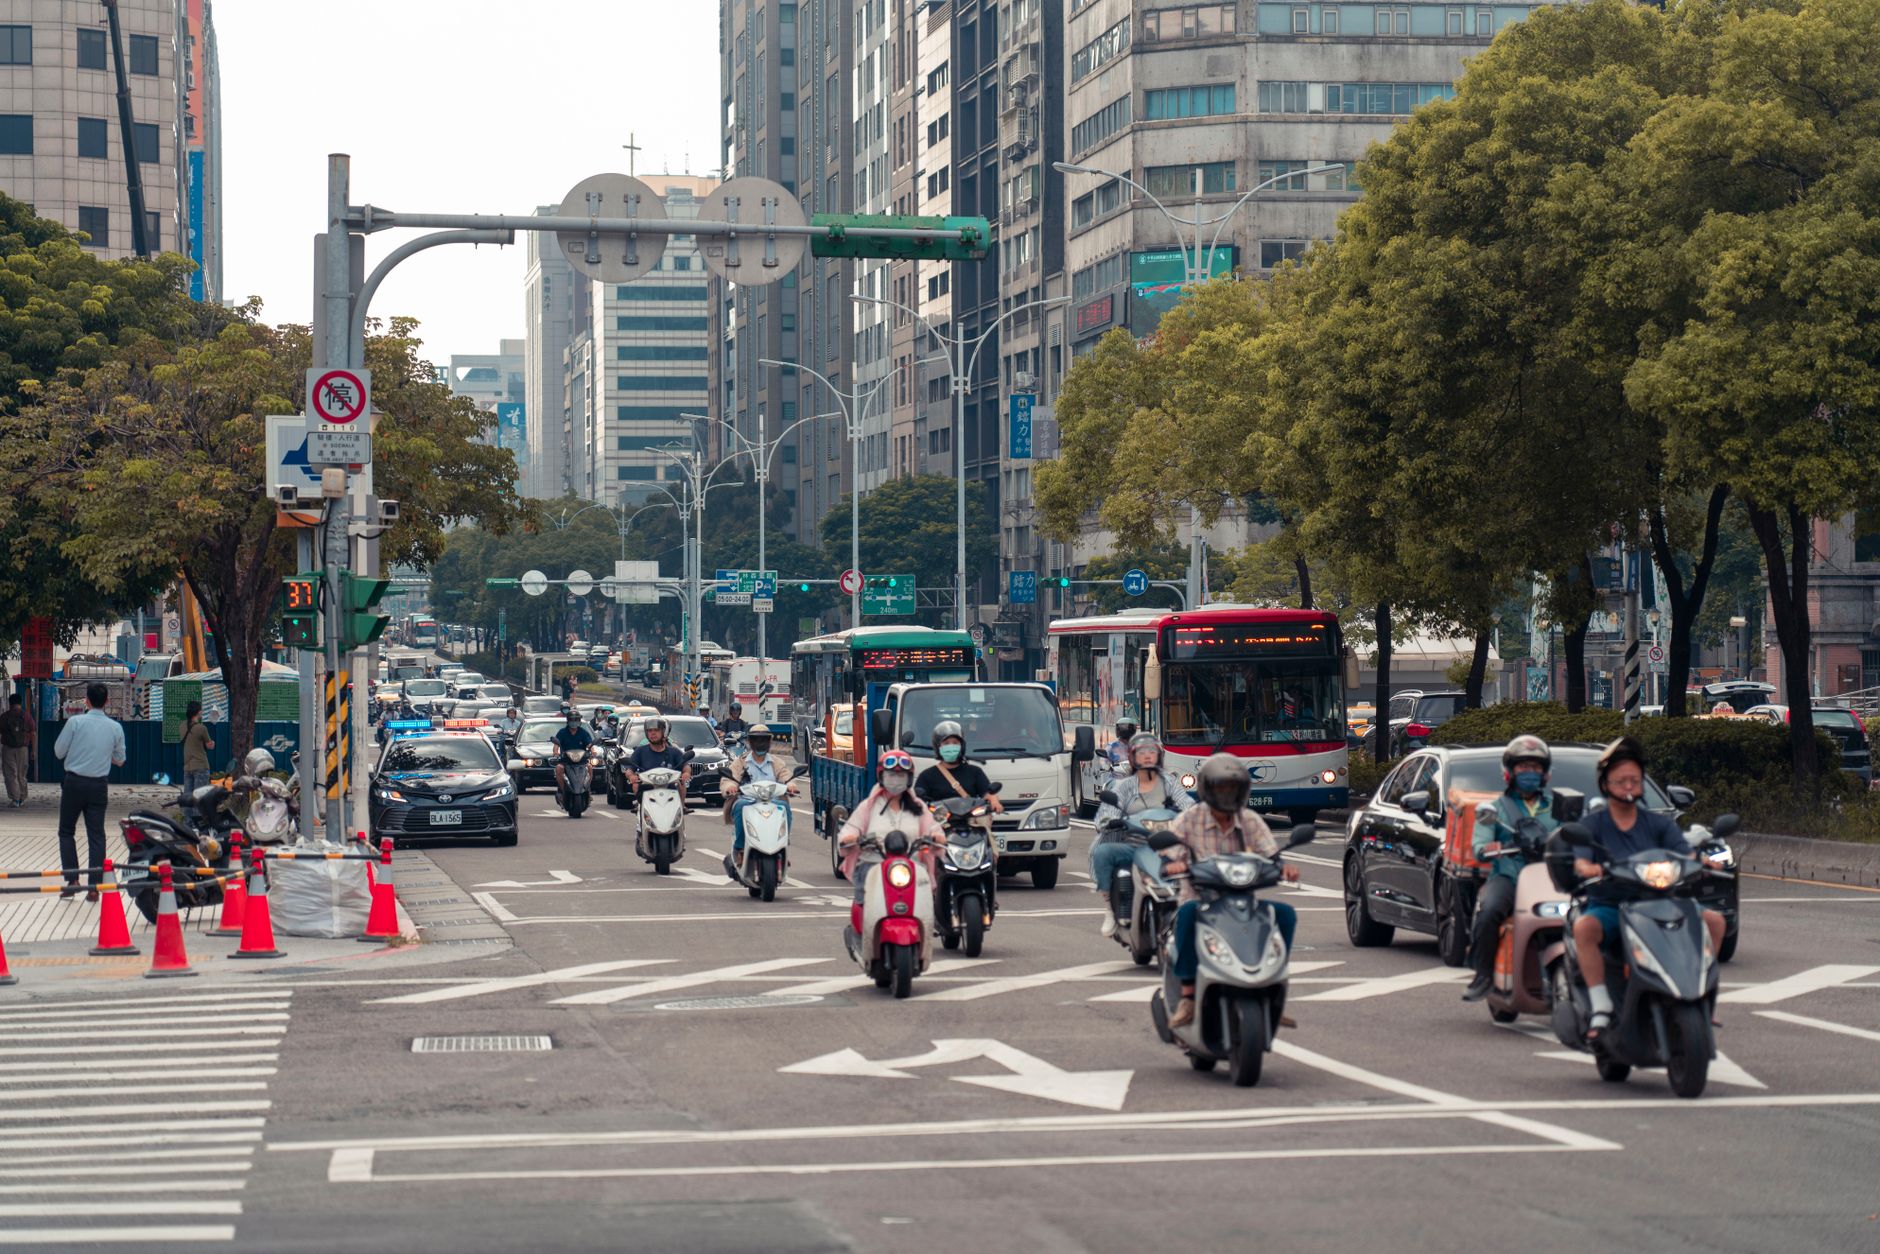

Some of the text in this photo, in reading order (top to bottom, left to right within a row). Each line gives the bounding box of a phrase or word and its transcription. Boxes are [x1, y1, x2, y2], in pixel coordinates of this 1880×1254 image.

[324, 382, 352, 411] 停
[289, 582, 312, 608] 37
[880, 606, 898, 614] 240m
